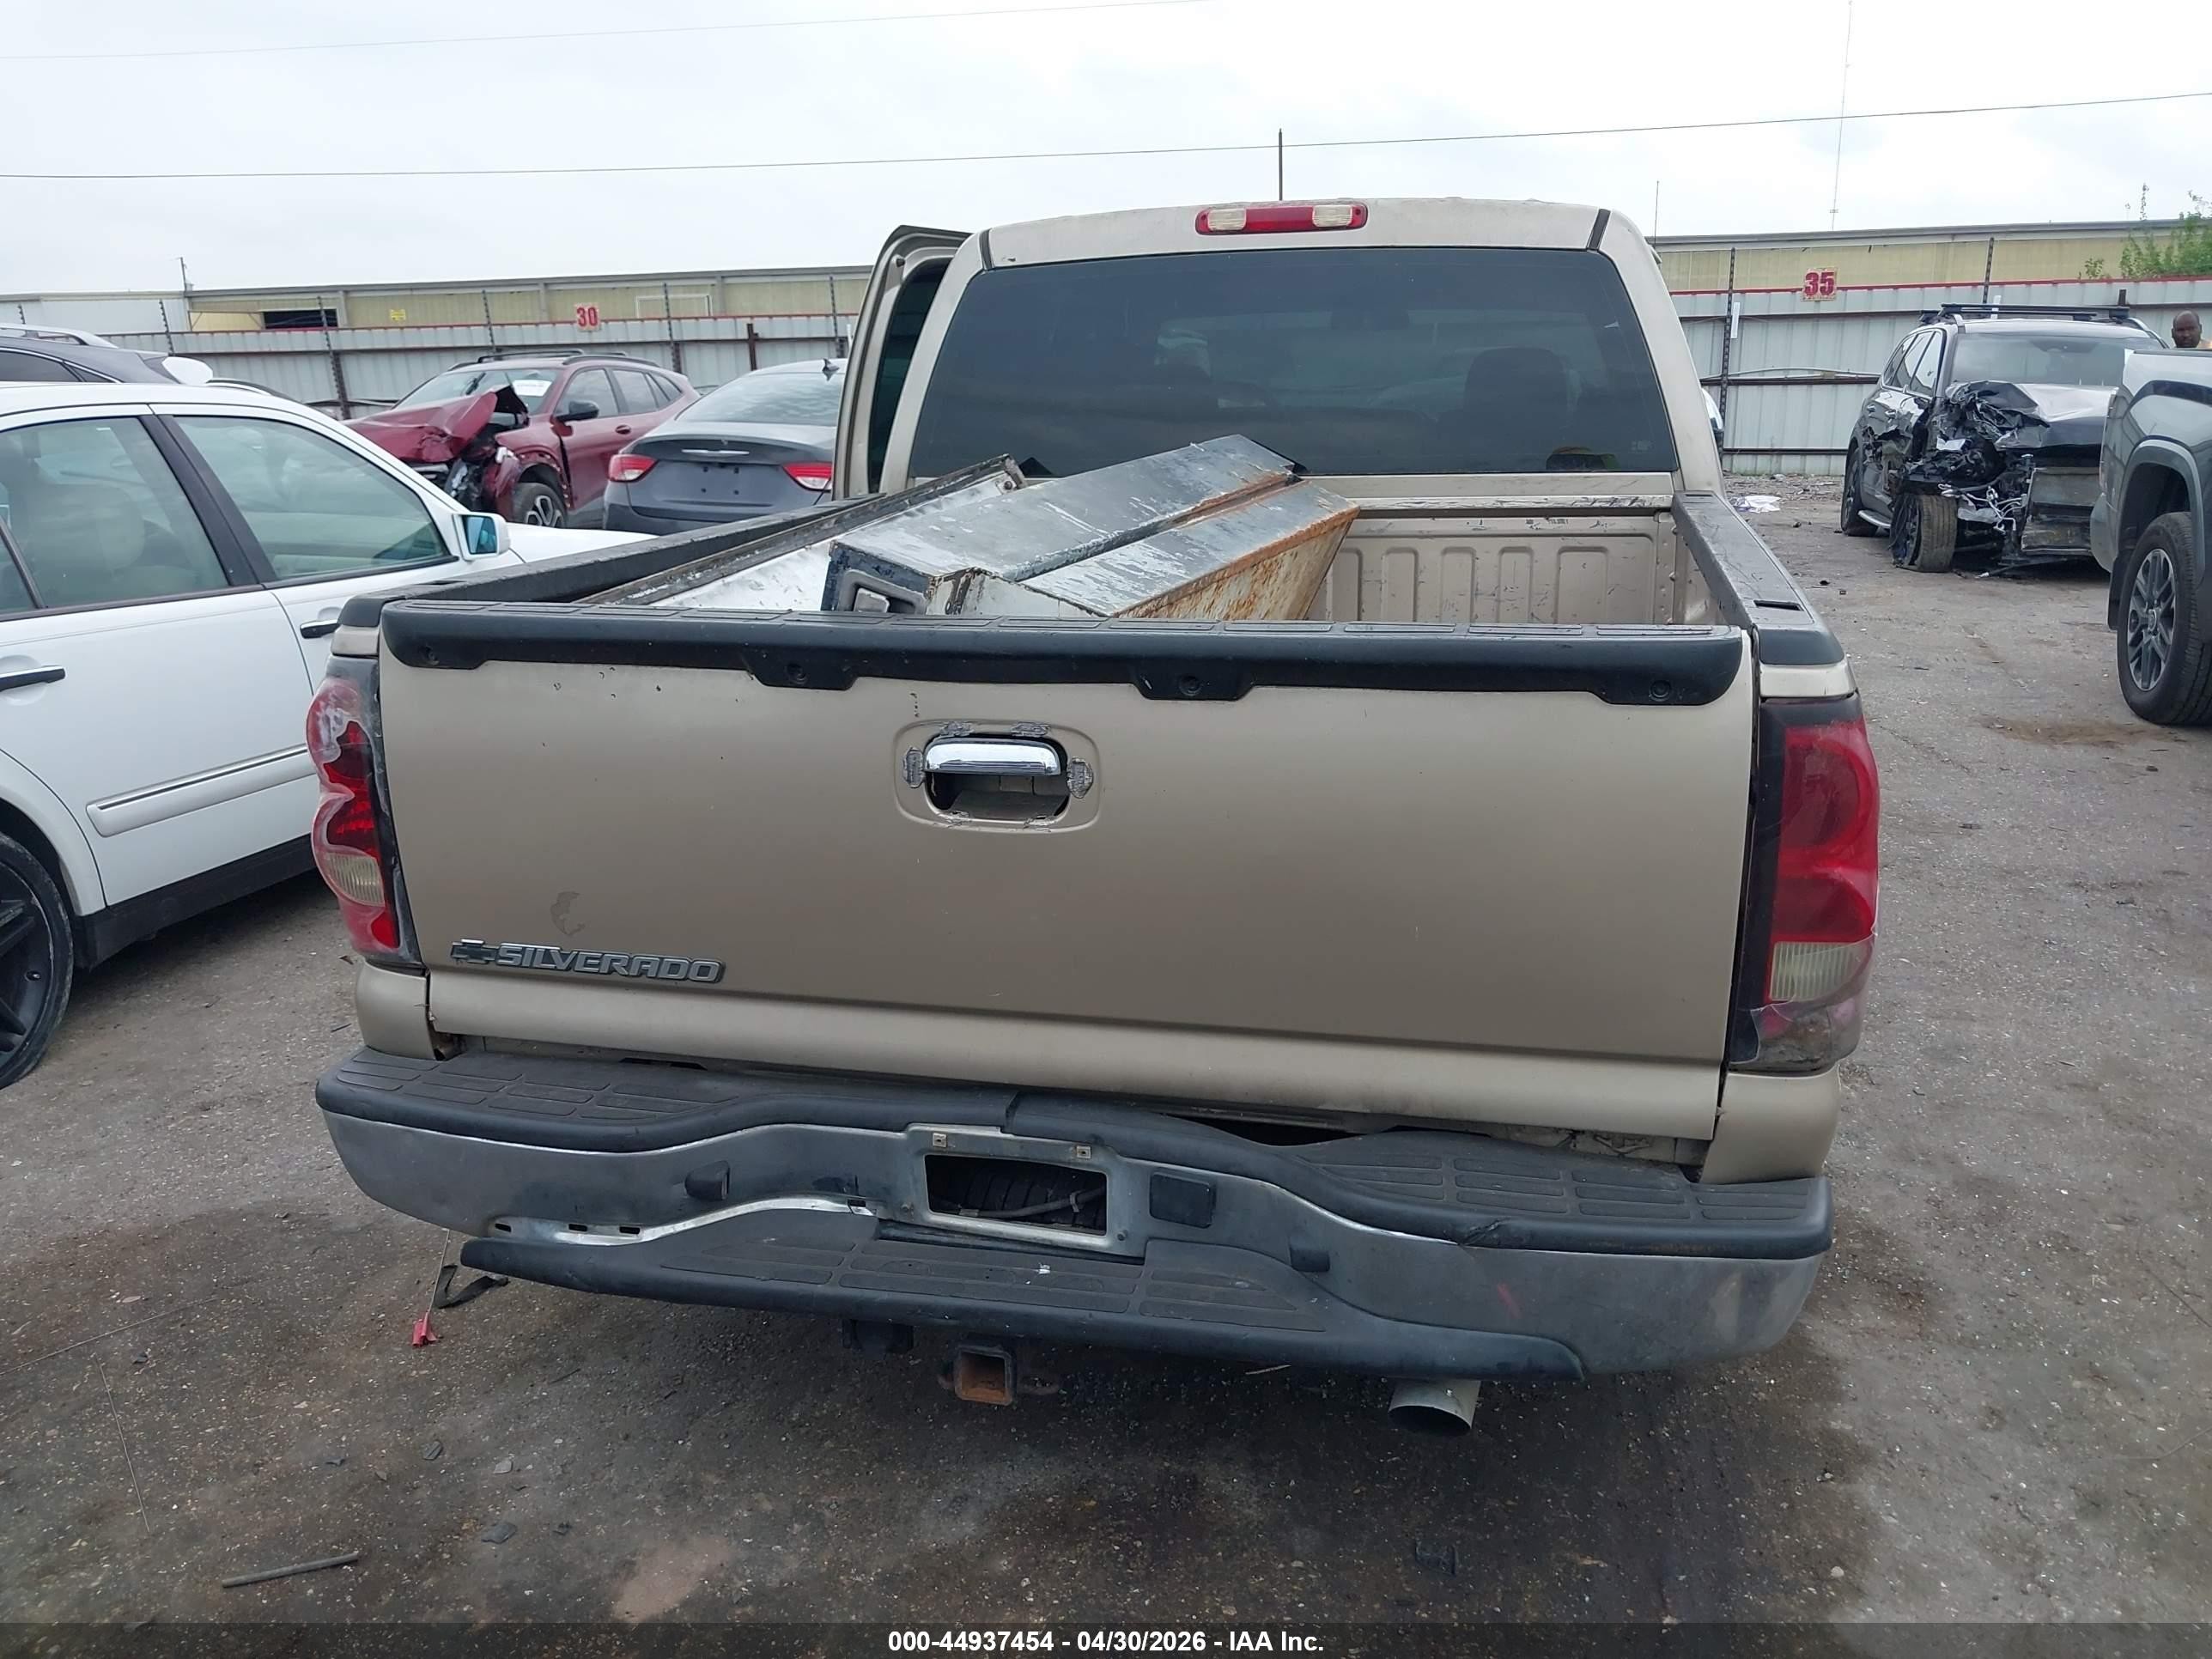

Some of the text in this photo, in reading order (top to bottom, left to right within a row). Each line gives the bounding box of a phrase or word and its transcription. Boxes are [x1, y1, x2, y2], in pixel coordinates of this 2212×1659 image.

[1804, 271, 1835, 296] 35
[576, 307, 599, 327] 30
[496, 945, 723, 982] SILVERADO
